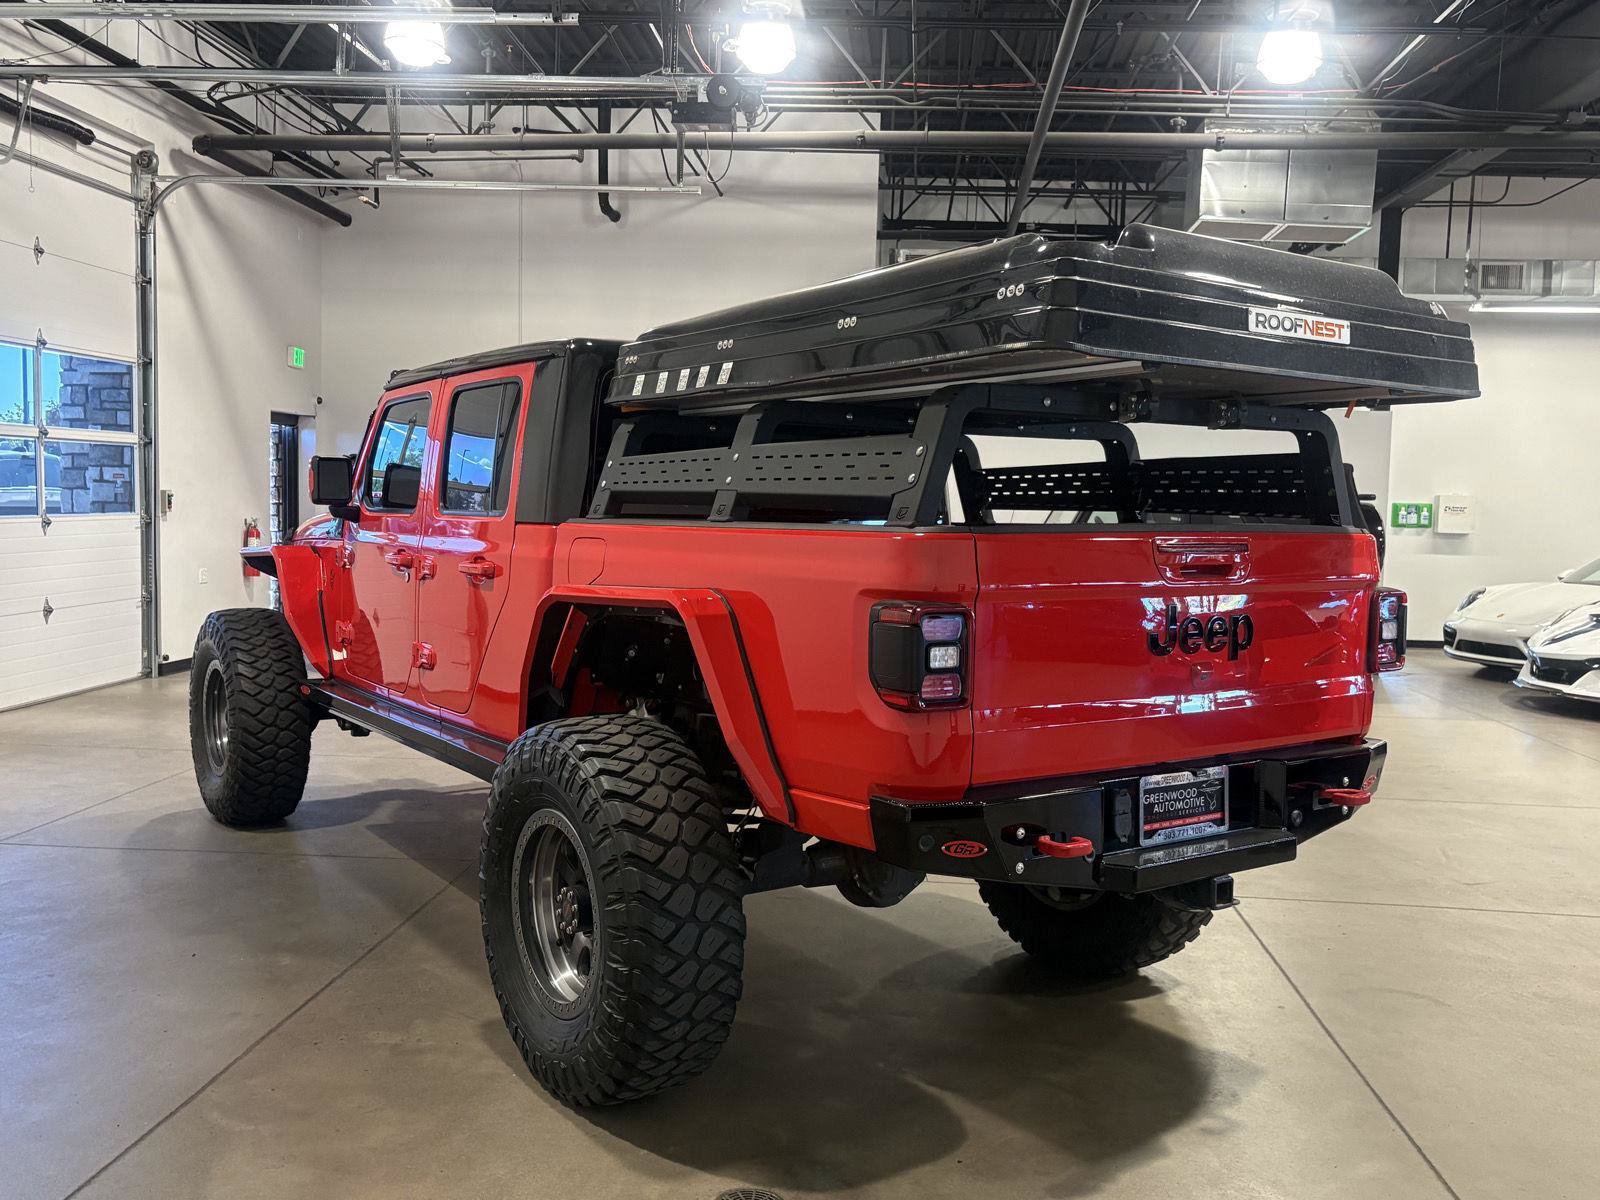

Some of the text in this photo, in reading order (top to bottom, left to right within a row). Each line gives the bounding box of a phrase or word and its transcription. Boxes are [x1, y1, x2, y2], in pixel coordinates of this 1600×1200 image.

[1255, 312, 1345, 340] ROOFNEST
[1148, 604, 1254, 661] Jeep
[1143, 787, 1198, 805] GREENWOOD
[1153, 796, 1205, 814] AUTOMOTIVE
